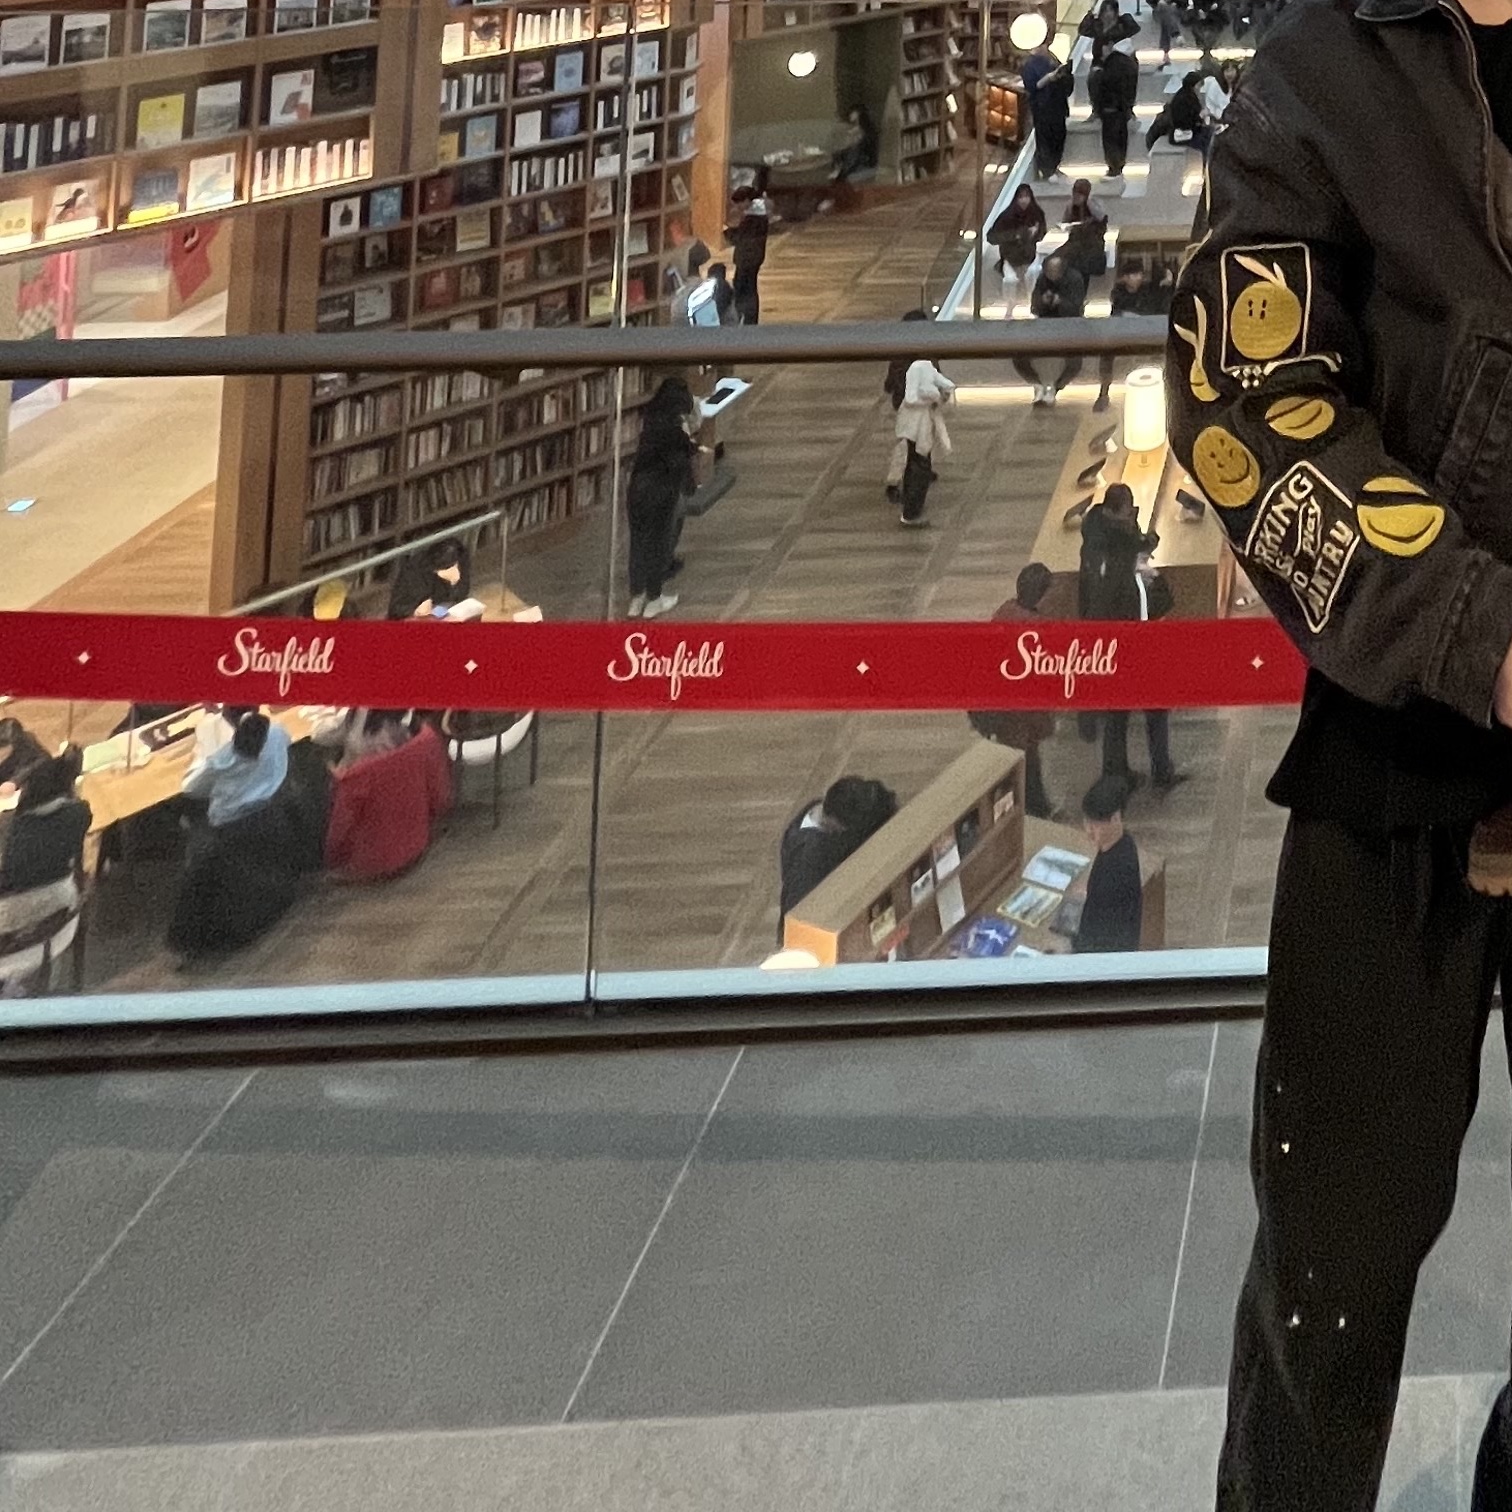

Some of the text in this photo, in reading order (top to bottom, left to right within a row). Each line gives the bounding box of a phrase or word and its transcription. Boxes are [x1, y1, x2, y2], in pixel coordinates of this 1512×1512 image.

[217, 628, 335, 696] Starfield
[608, 633, 724, 701] Starfield
[1001, 632, 1118, 699] Starfield
